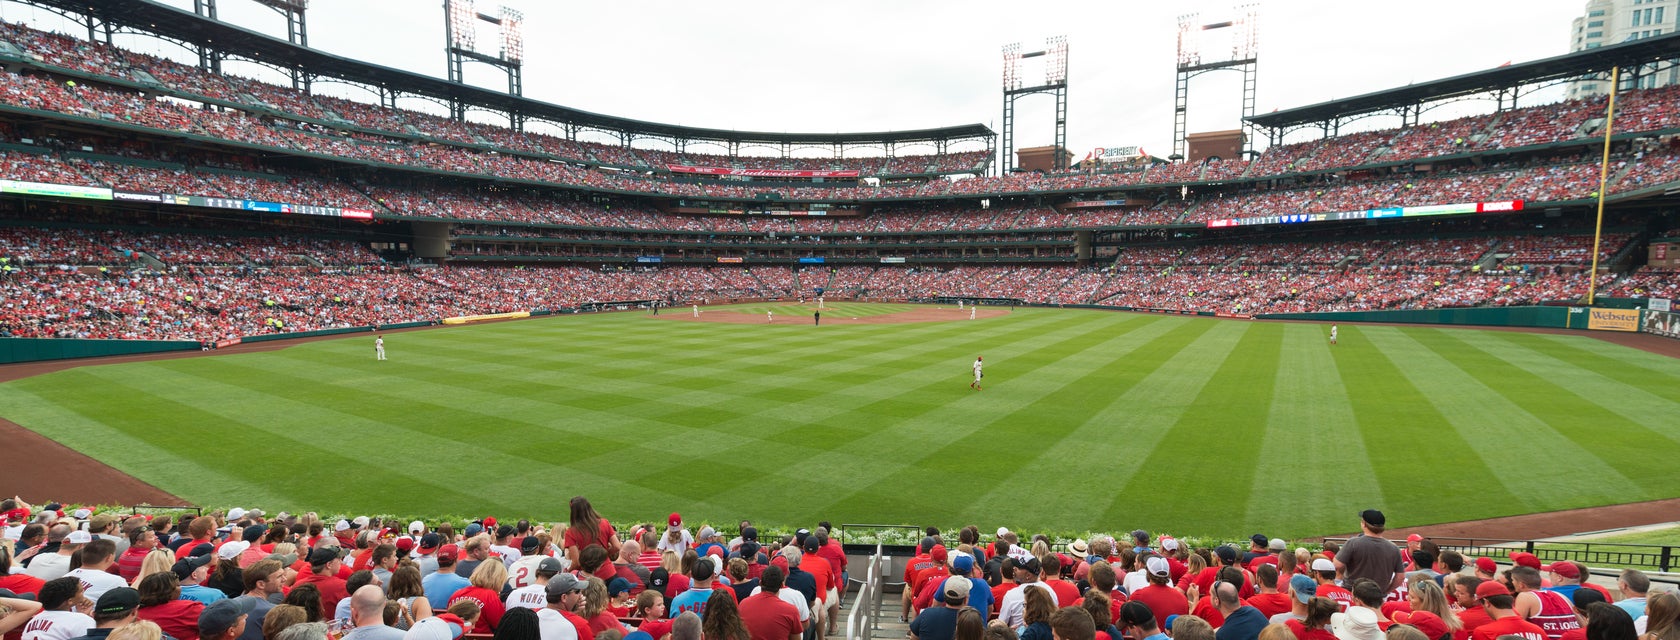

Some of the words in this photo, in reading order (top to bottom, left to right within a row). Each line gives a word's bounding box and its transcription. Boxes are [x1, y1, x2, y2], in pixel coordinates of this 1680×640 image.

[1592, 311, 1637, 321] Webster
[515, 567, 528, 587] 2
[520, 593, 544, 604] WONG
[1543, 622, 1558, 630] ST.
